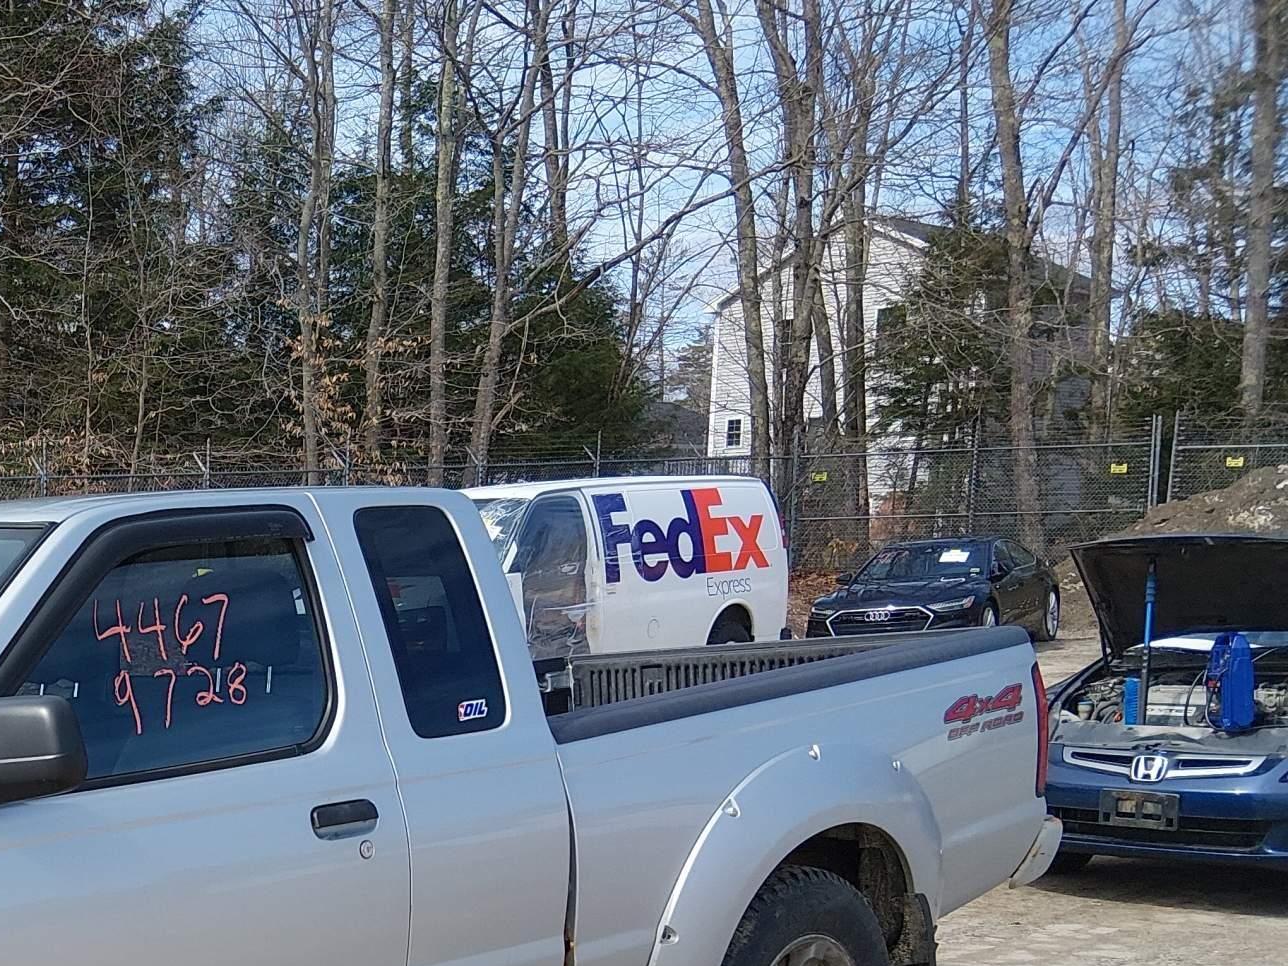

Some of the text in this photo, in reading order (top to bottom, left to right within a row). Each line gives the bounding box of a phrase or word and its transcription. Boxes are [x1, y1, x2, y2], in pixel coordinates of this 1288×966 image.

[591, 487, 770, 584] FedEx
[706, 576, 752, 600] Express
[93, 592, 229, 663] 4467
[114, 662, 248, 735] 9728
[947, 710, 1024, 741] OFF ROAD
